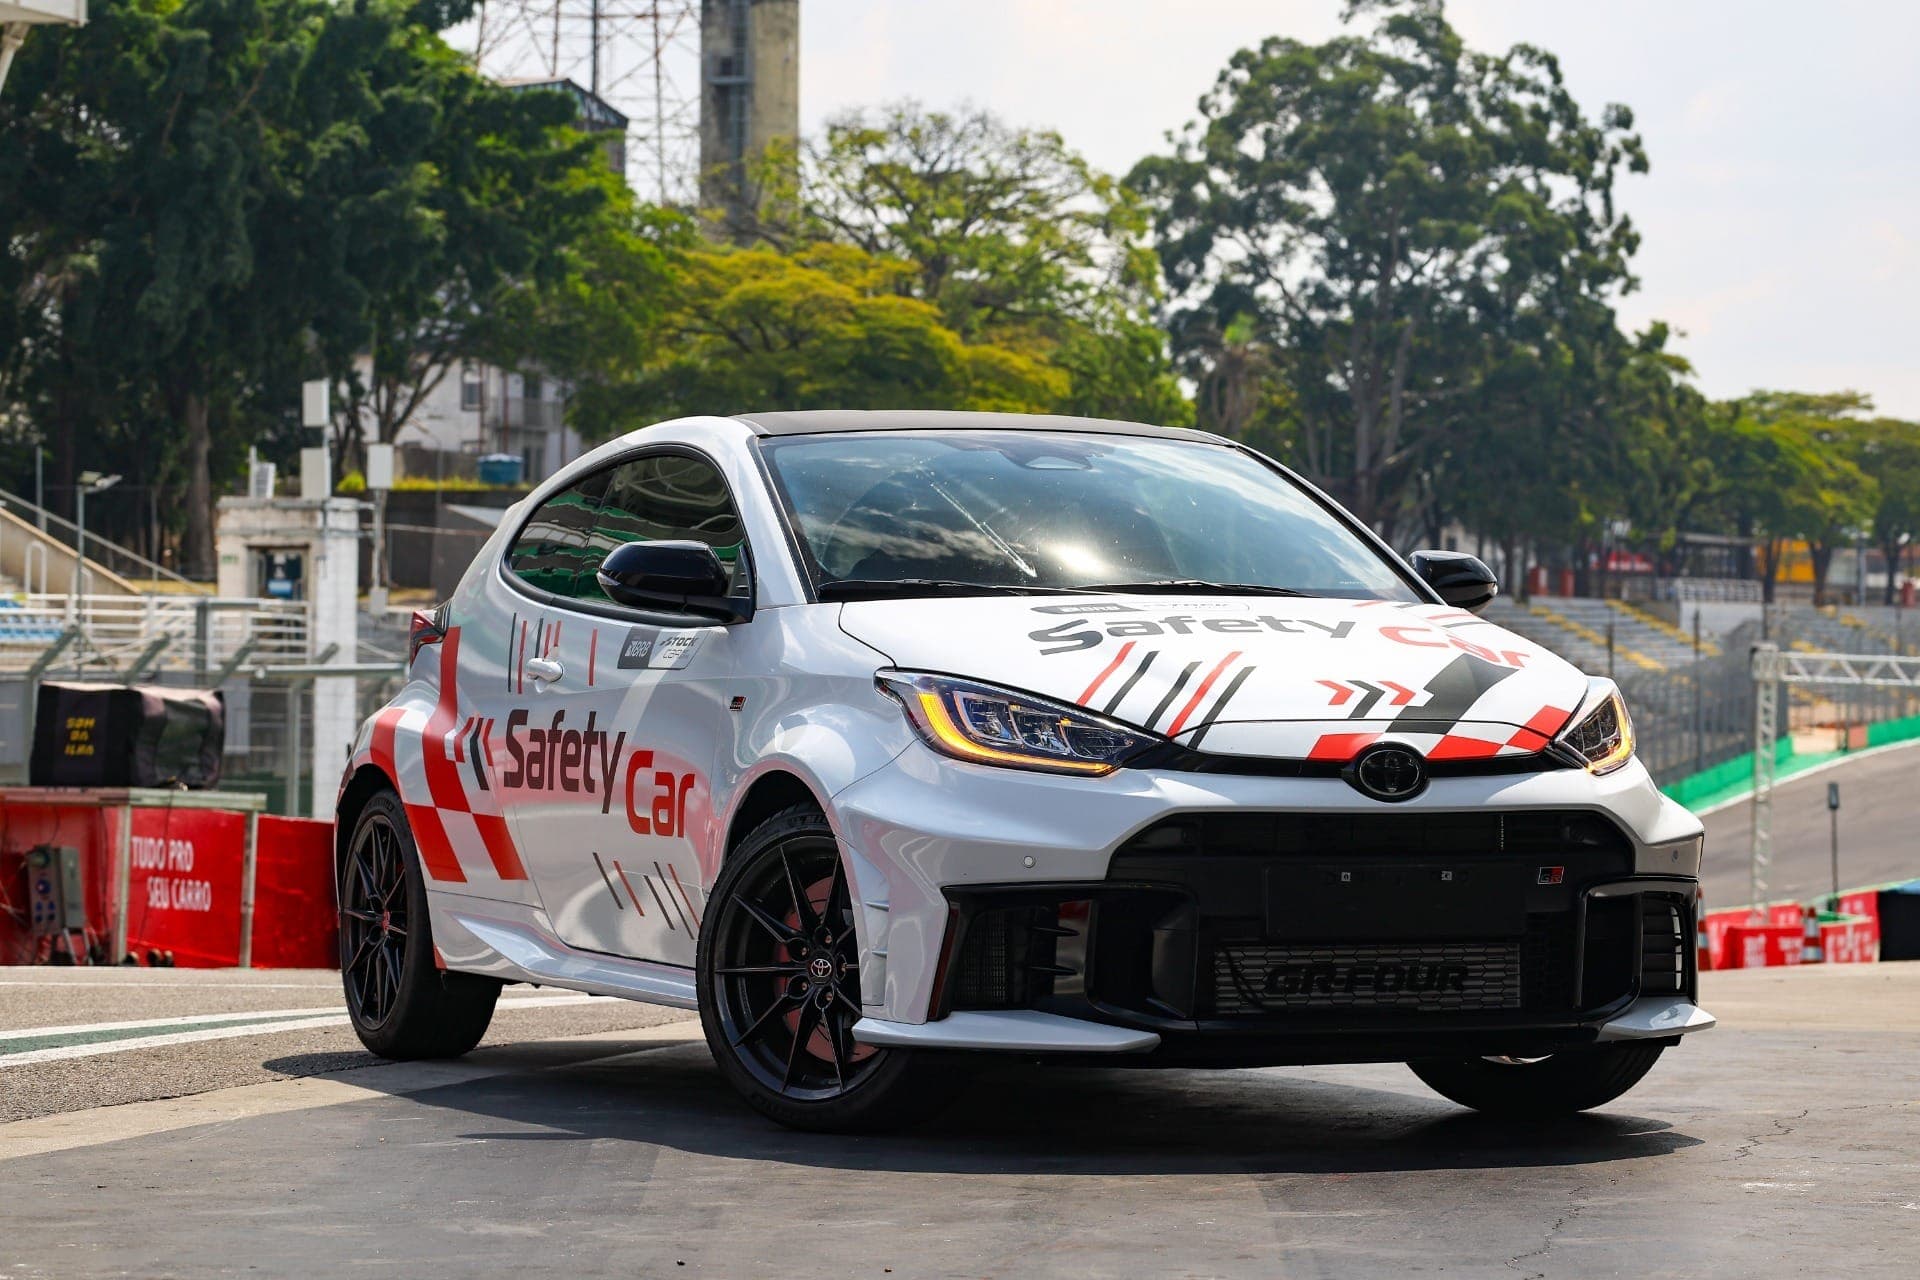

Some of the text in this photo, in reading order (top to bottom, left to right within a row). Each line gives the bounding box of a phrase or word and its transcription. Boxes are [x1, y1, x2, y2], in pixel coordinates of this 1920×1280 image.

[660, 637, 699, 647] STOCK
[1028, 615, 1530, 667] Safety Car
[504, 709, 695, 838] Safety Car
[131, 836, 194, 872] TUDO PRO
[147, 876, 212, 912] SEU CARRO
